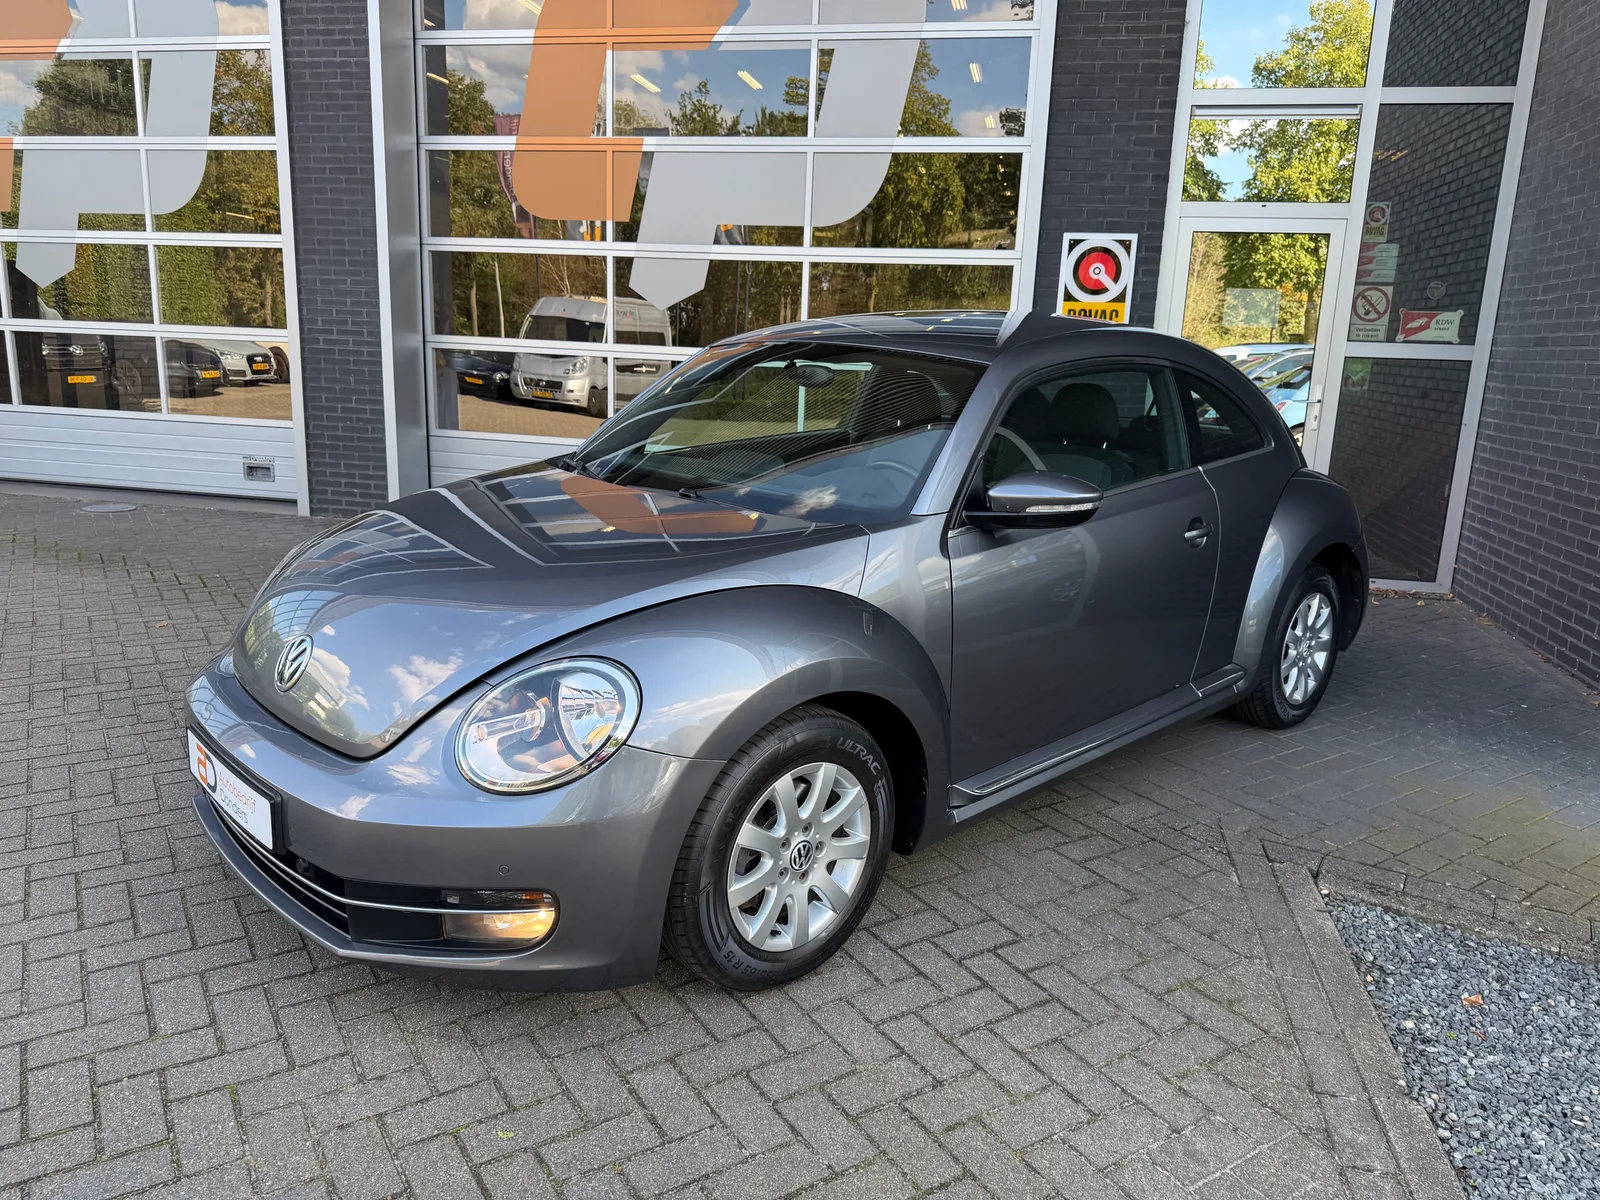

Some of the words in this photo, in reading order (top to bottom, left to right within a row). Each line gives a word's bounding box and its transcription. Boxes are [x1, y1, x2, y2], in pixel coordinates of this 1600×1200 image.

[837, 736, 881, 776] ULTRAC
[218, 771, 257, 815] Autobedrijf
[219, 787, 249, 824] Donders
